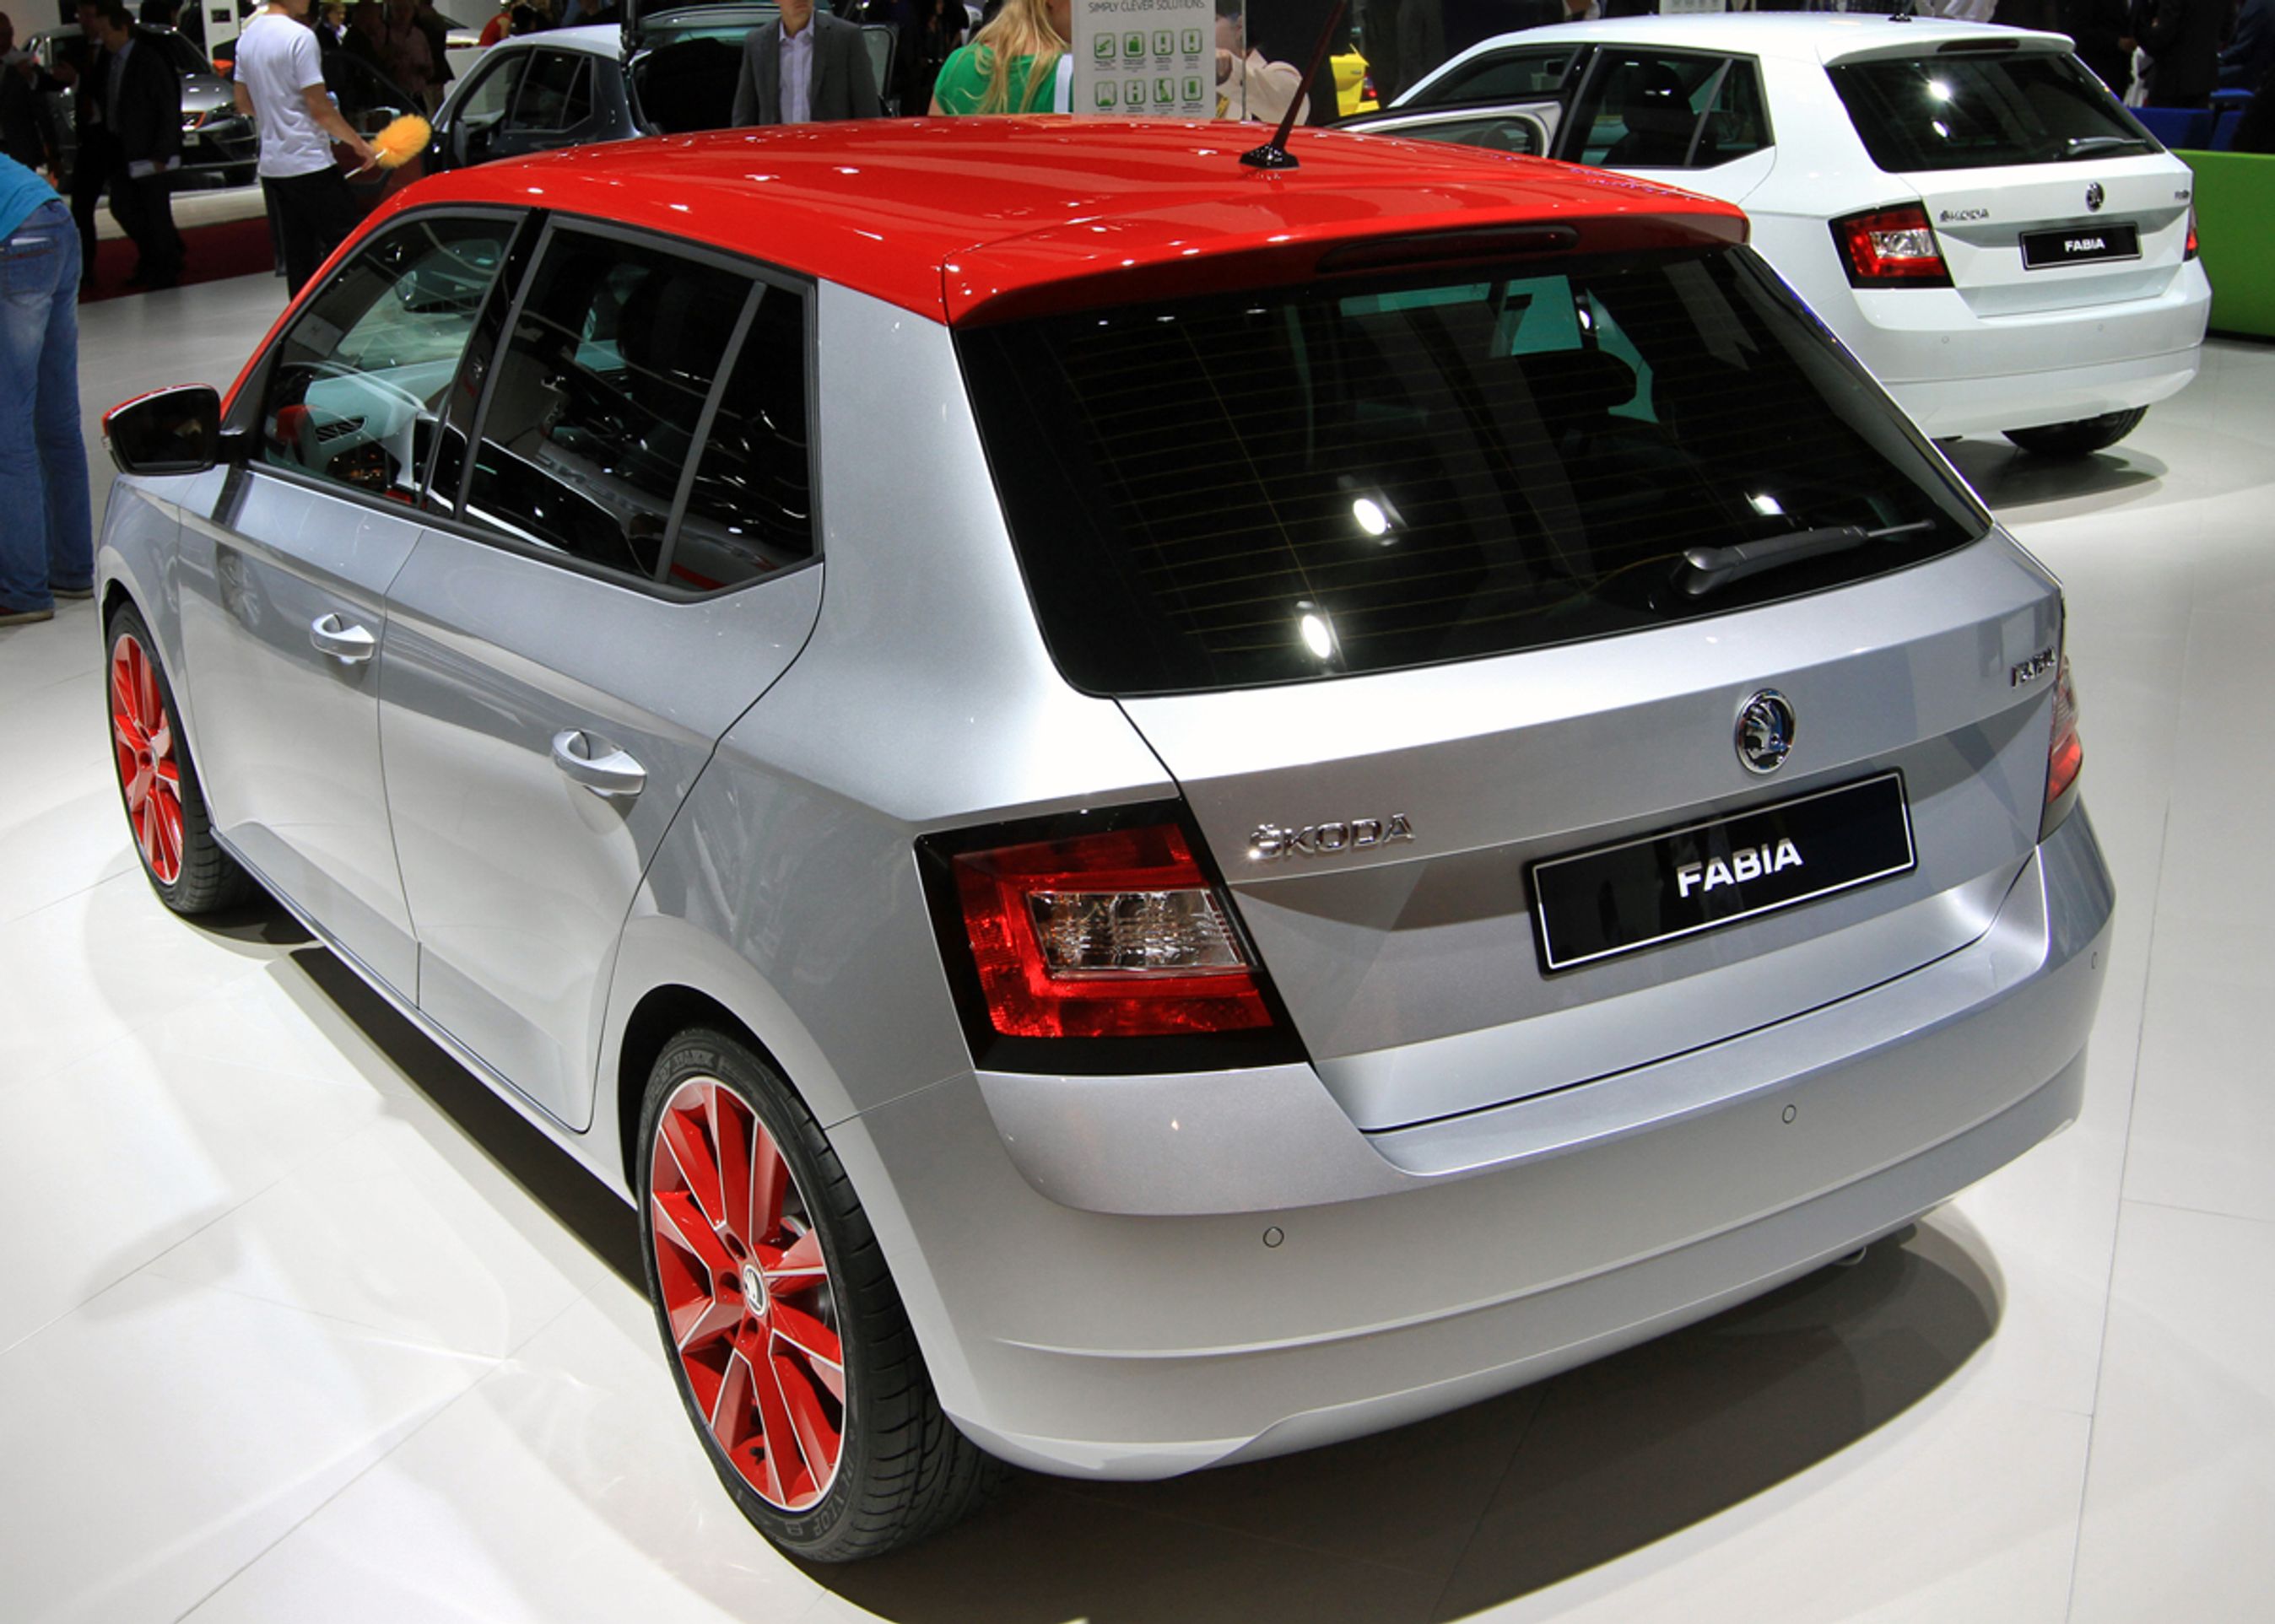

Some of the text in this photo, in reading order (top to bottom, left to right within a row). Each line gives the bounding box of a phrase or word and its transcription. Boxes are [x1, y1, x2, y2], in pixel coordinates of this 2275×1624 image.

[1121, 0, 1154, 12] CLEVER
[2064, 238, 2105, 253] FABIA
[1676, 838, 1803, 898] FABIA
